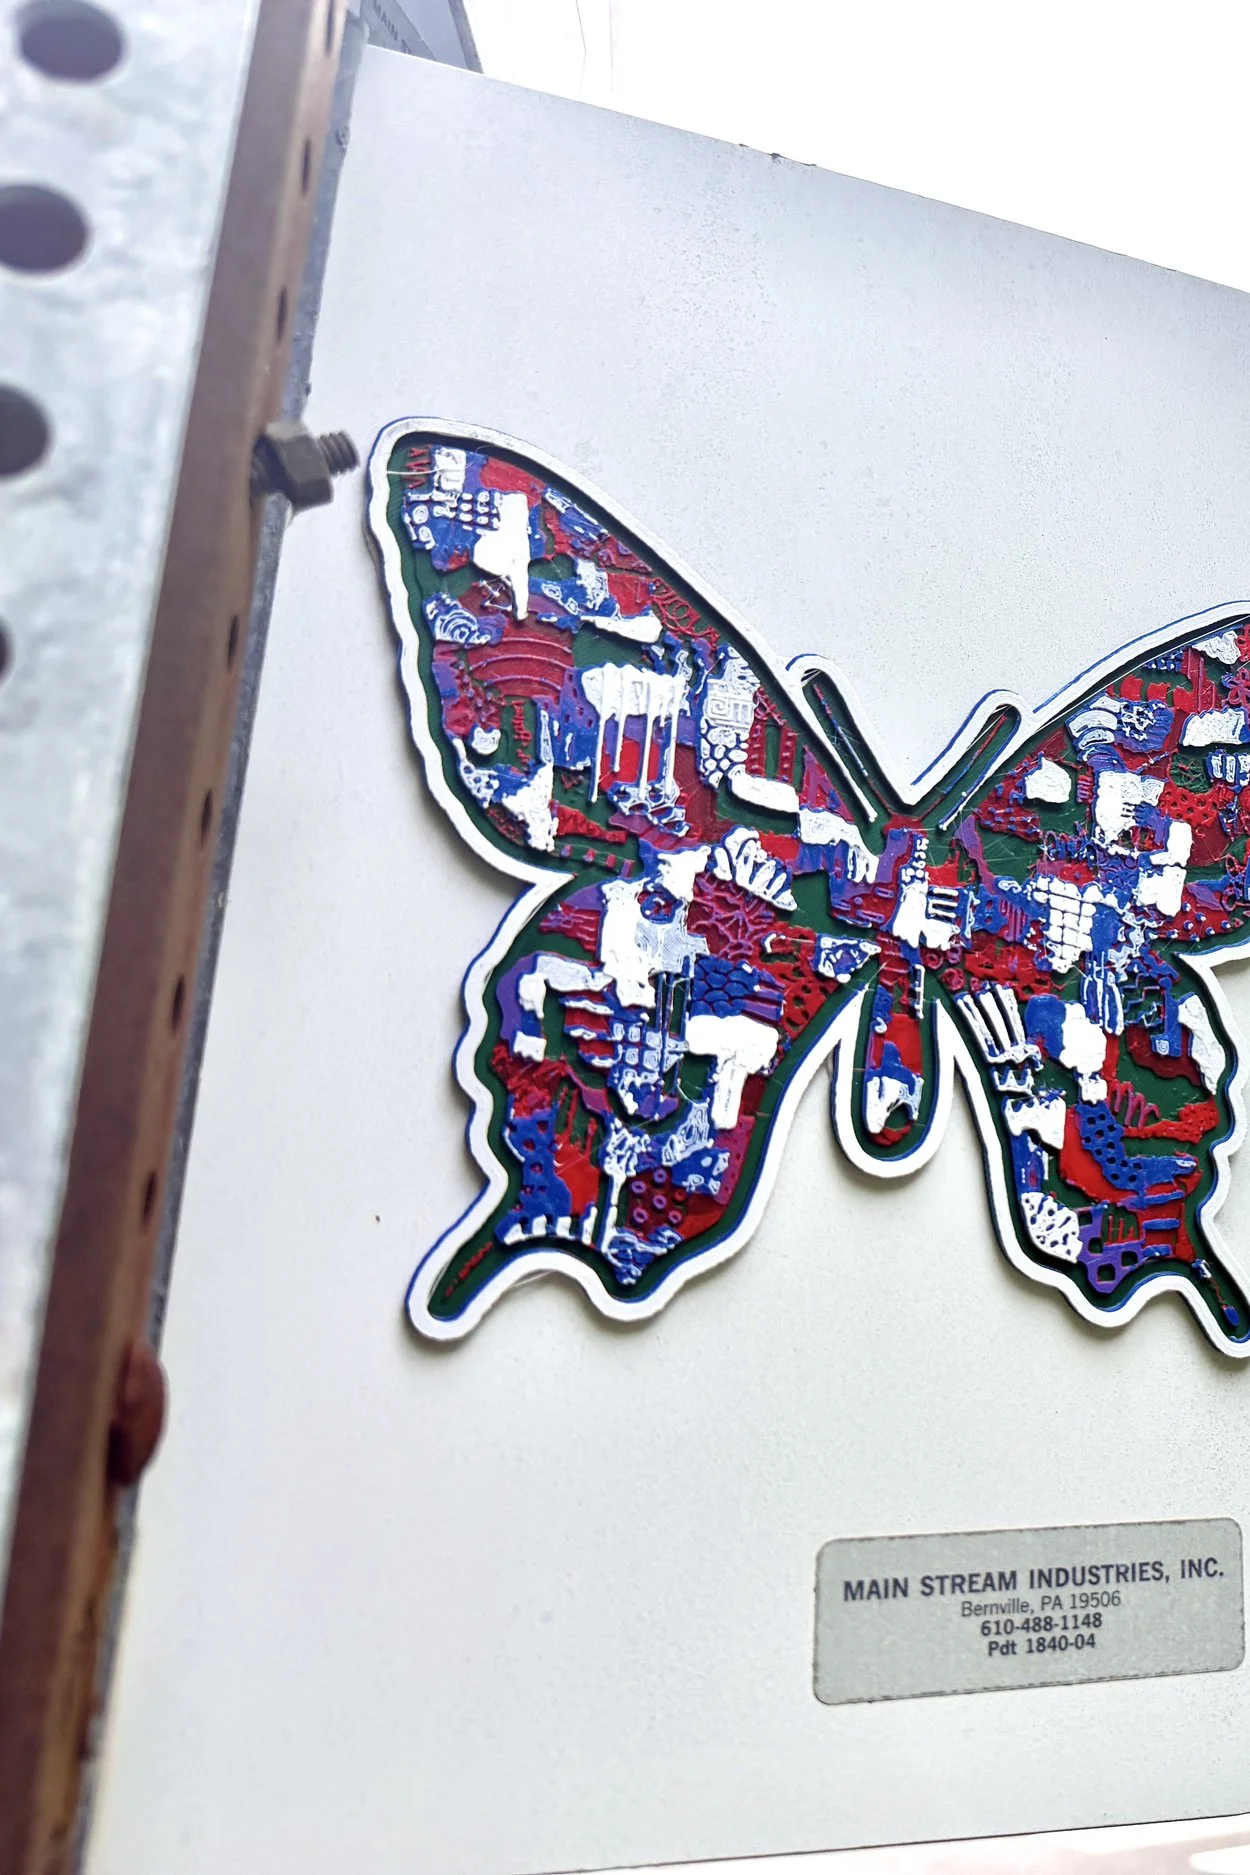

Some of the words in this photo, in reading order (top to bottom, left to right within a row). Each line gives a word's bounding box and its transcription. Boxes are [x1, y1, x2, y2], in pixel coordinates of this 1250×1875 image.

[843, 1577, 910, 1602] MAIN
[919, 1570, 1018, 1597] STREAM
[1029, 1561, 1171, 1590] INDUSTRIES,
[1180, 1557, 1225, 1580] INC.
[960, 1599, 1035, 1618] Bernville,
[1040, 1595, 1064, 1612] PA
[1070, 1590, 1122, 1610] 19506
[980, 1612, 1104, 1637] 610-488-1148
[988, 1638, 1018, 1658] Pdt
[1025, 1633, 1097, 1655] 1840-04
